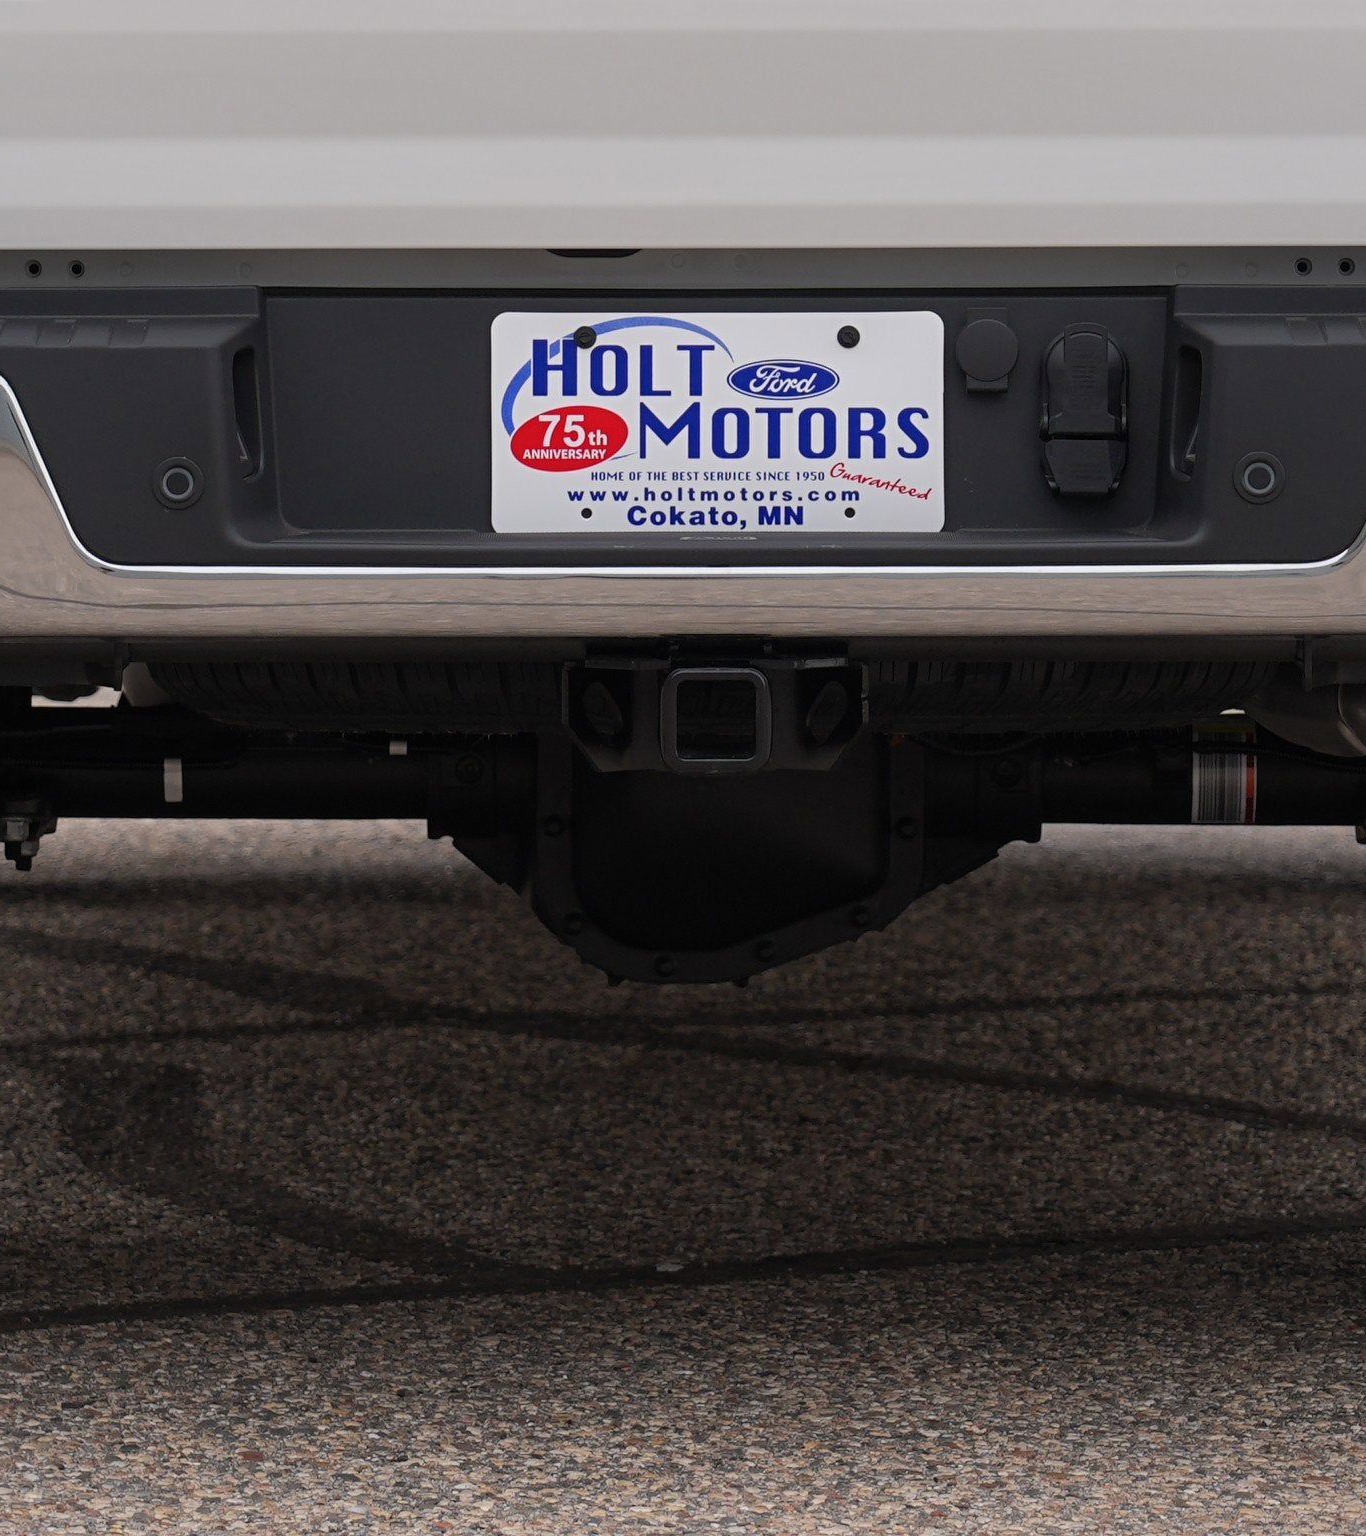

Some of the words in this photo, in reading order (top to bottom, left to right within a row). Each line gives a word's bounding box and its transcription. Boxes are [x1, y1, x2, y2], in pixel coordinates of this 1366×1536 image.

[532, 339, 716, 397] HOLT
[748, 364, 818, 394] Ford
[538, 414, 609, 448] 75th
[639, 401, 930, 460] MOTORS
[522, 448, 607, 460] ANNIVERSARY
[590, 470, 625, 482] HOME
[628, 470, 643, 482] OF
[646, 470, 668, 482] THE
[671, 470, 700, 482] BEST
[703, 470, 752, 482] SERVICE
[755, 470, 791, 482] SINCE
[795, 470, 825, 482] 1950
[829, 461, 933, 501] Guaranteed
[566, 486, 860, 503] www.holtmotors.com
[626, 505, 747, 530] Cokato,
[758, 505, 804, 526] MN
